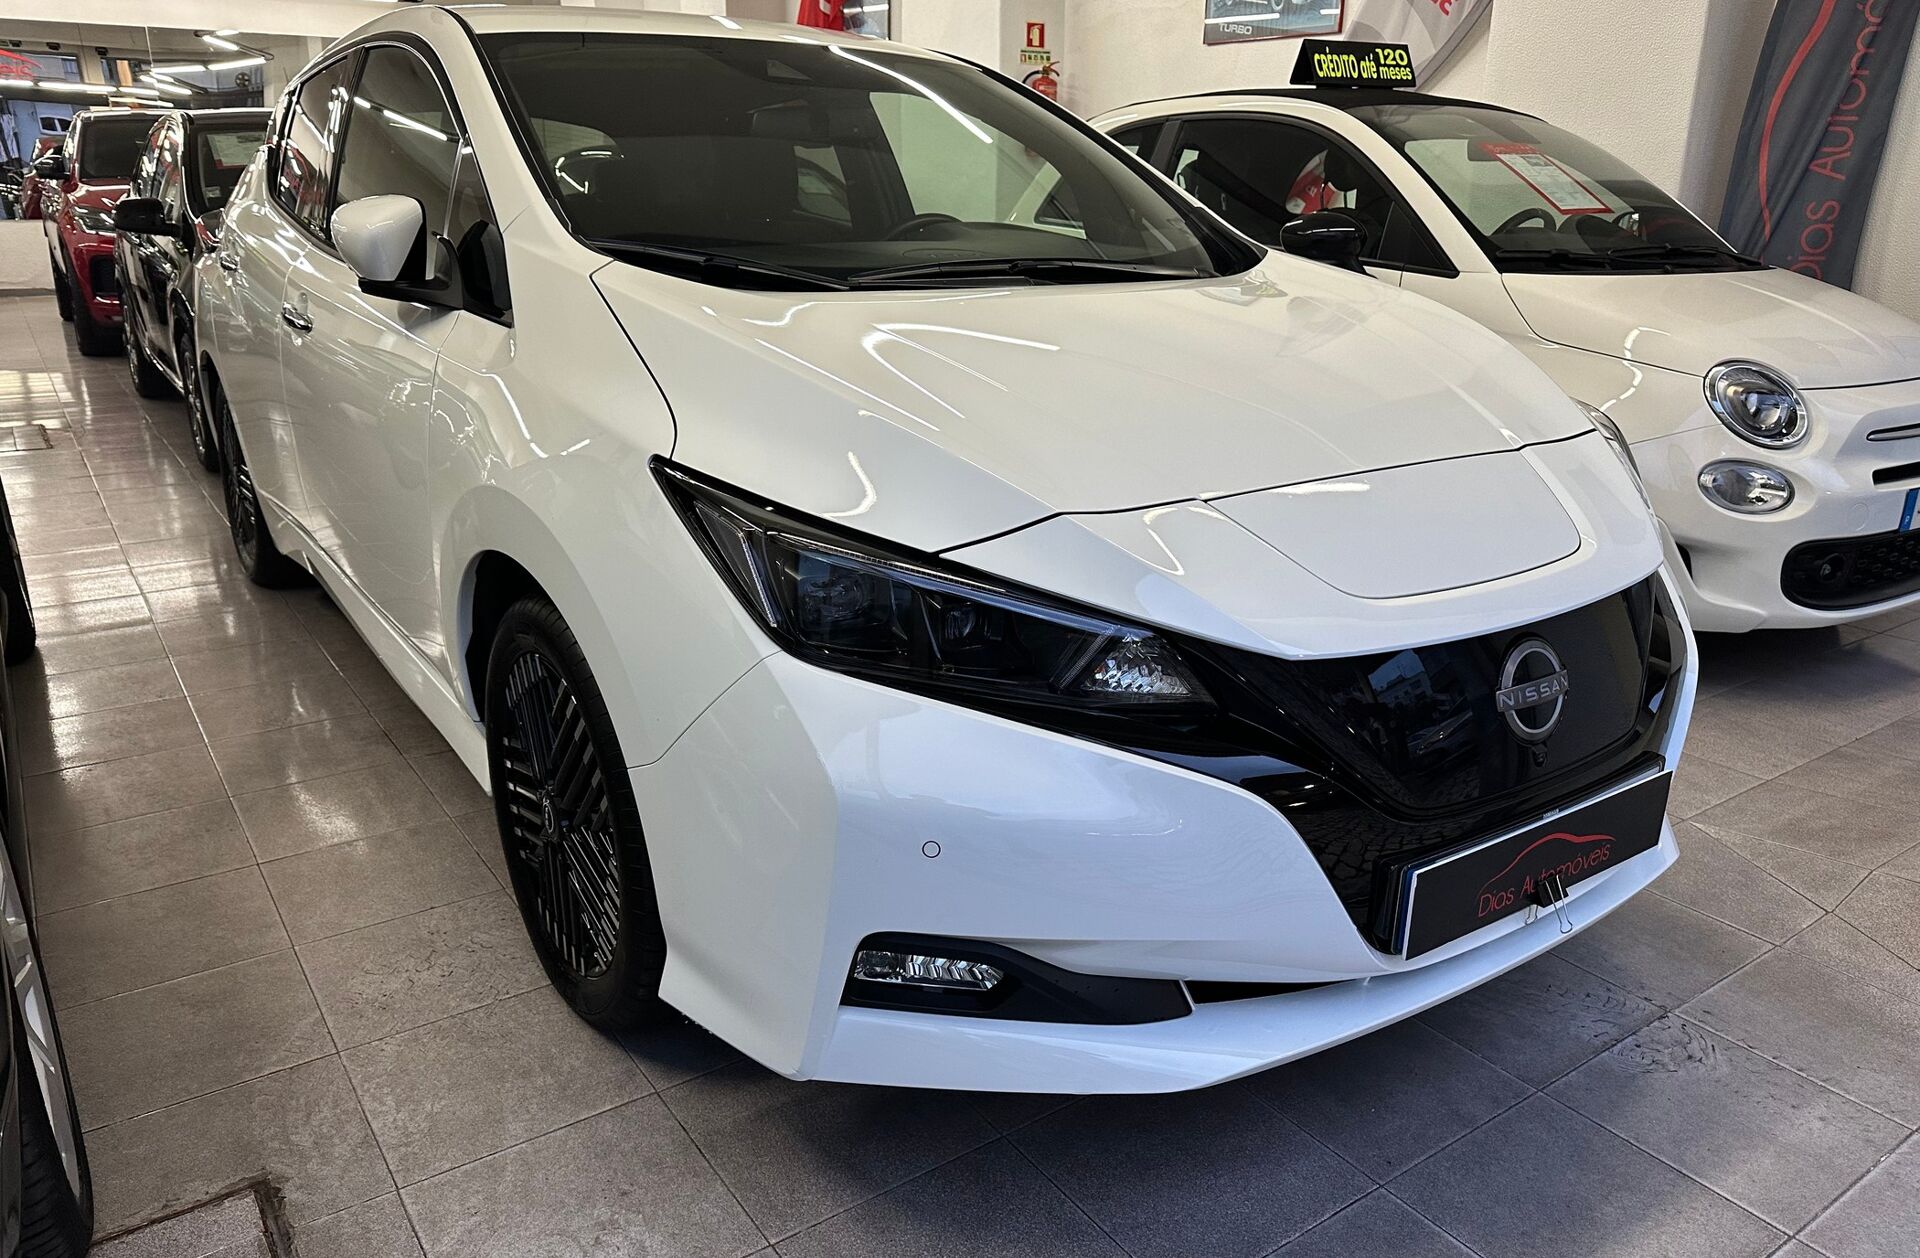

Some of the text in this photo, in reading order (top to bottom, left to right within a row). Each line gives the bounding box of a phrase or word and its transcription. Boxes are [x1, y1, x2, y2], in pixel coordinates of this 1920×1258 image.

[1219, 23, 1252, 35] TURBO
[1314, 46, 1377, 78] CRÉDITO até
[1375, 48, 1408, 66] 120
[1379, 66, 1412, 80] meses
[1499, 675, 1568, 708] NISSAN
[1478, 887, 1515, 918] Dias
